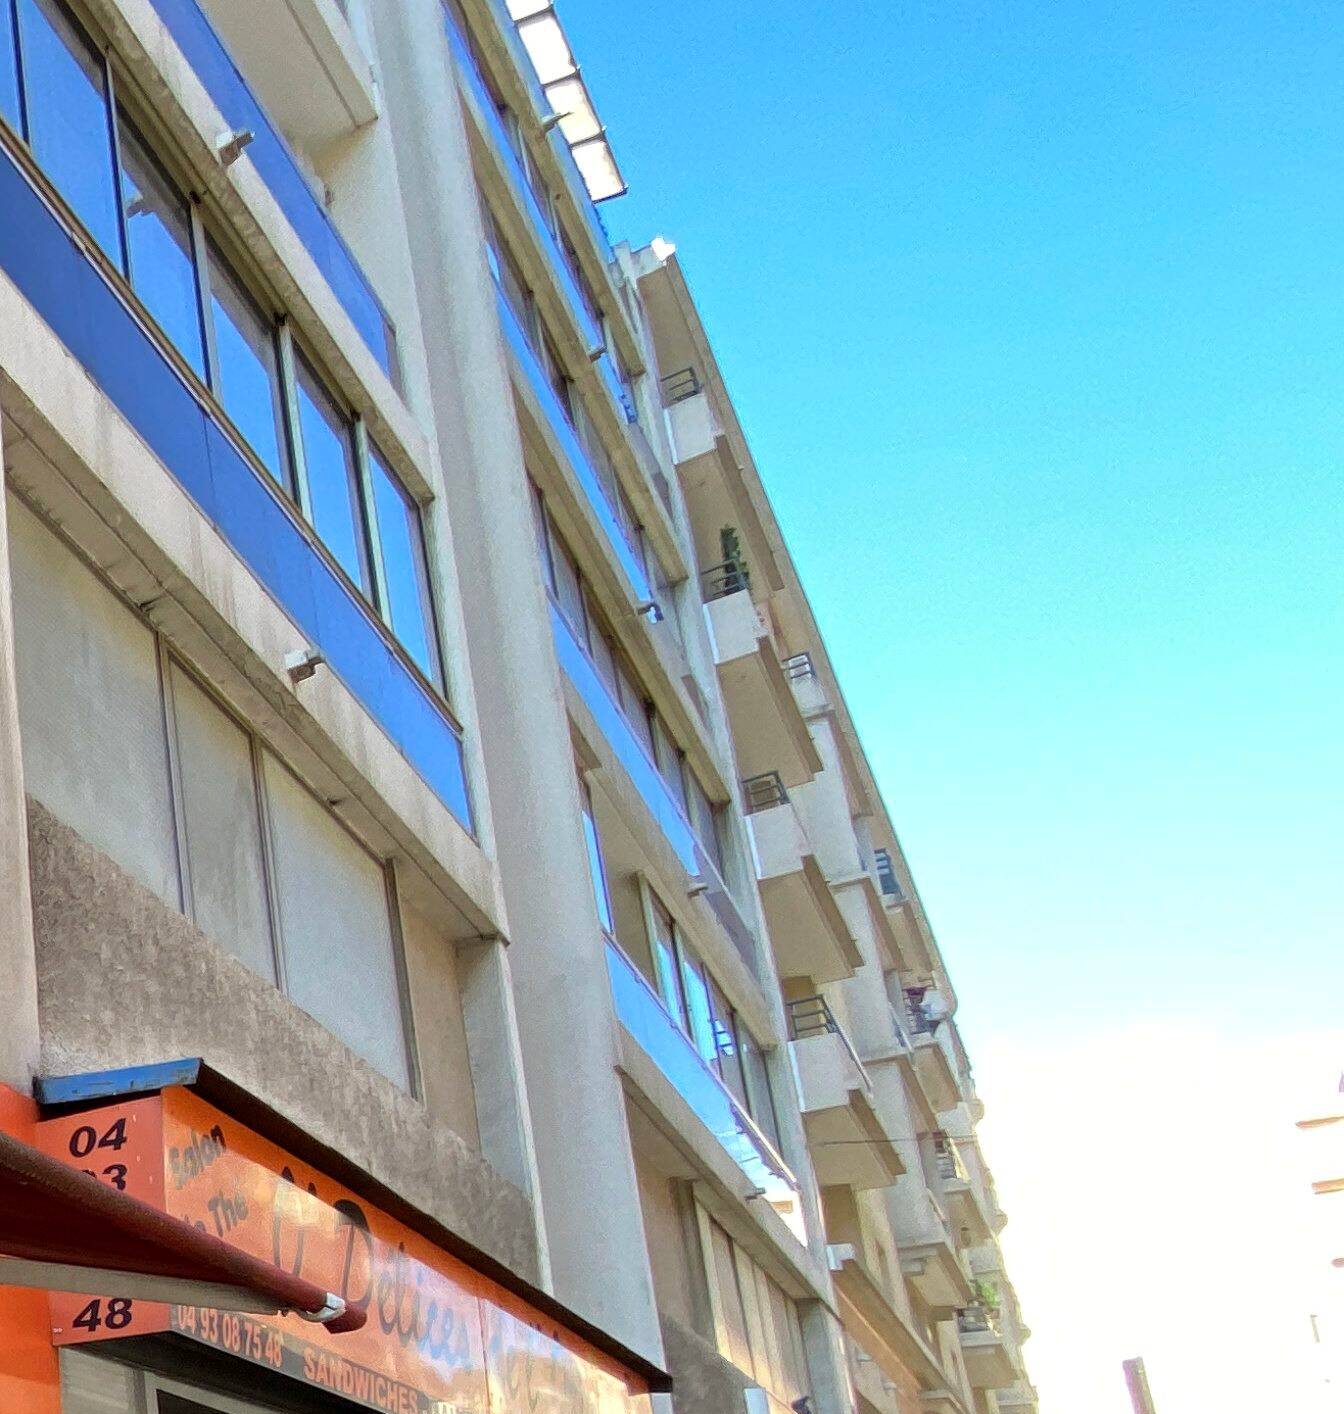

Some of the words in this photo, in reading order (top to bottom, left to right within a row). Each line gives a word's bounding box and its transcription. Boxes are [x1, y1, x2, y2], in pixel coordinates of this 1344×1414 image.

[68, 1117, 128, 1159] 04
[81, 1163, 129, 1192] 3
[71, 1297, 133, 1333] 48
[177, 1304, 196, 1335] 04
[200, 1306, 218, 1344] 93
[222, 1312, 241, 1353] 08
[244, 1320, 262, 1361] 75
[265, 1330, 284, 1368] 48
